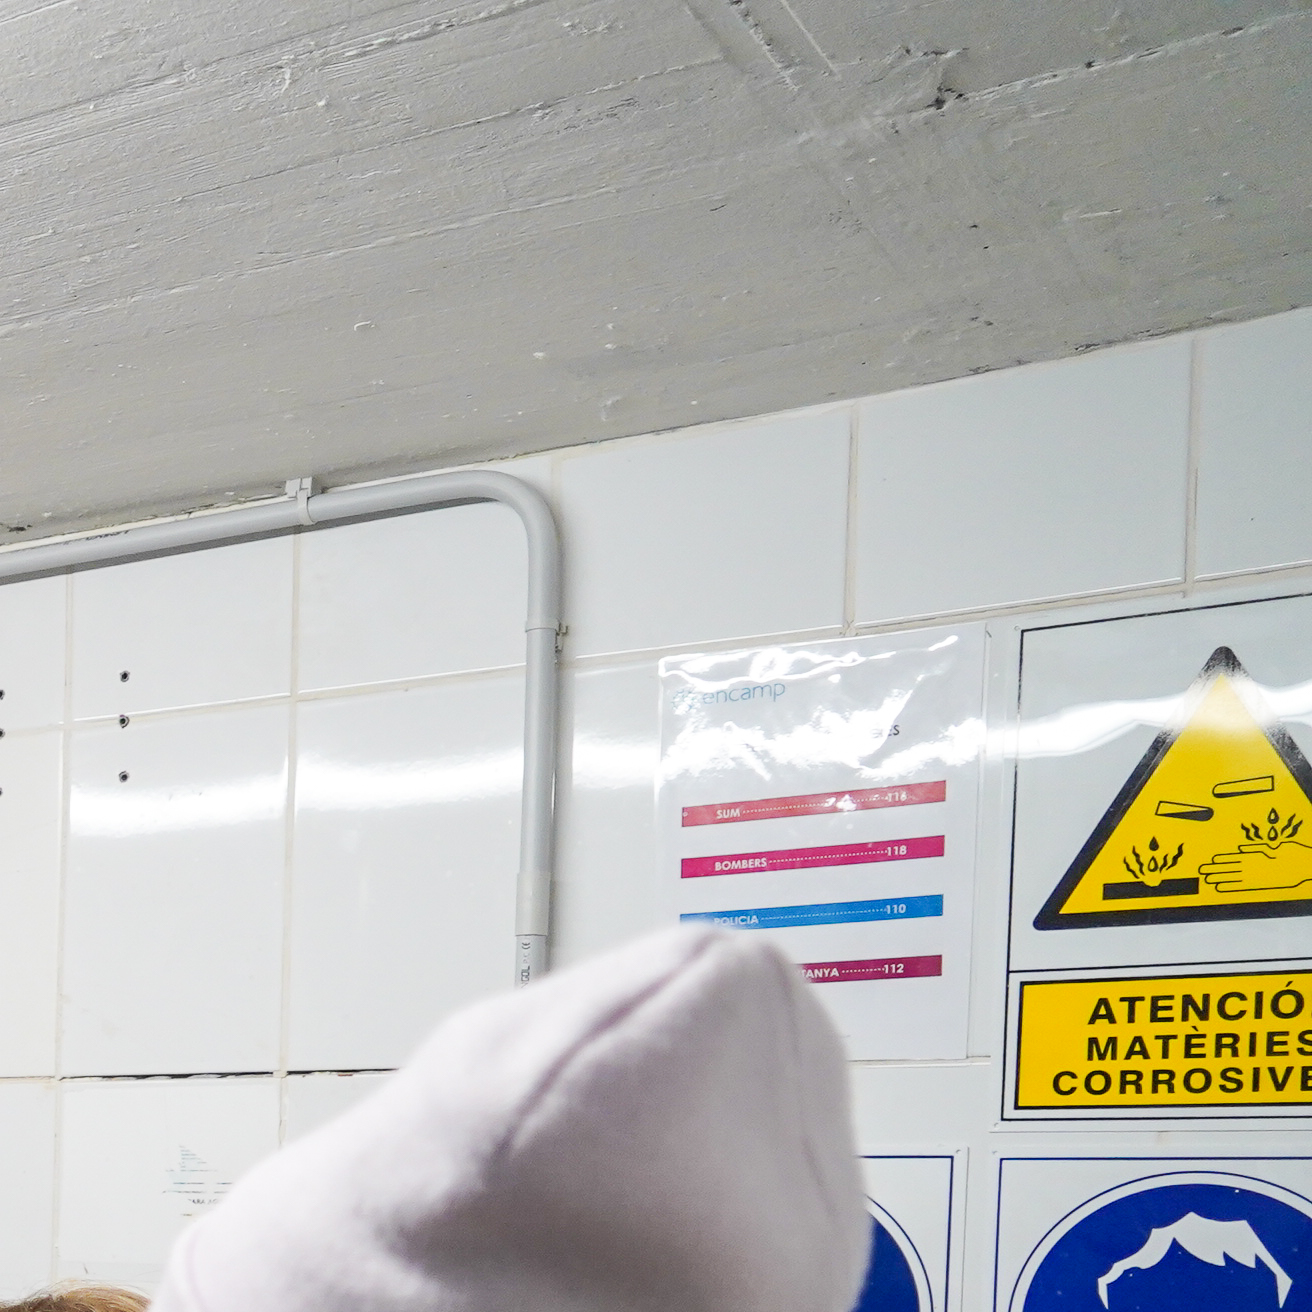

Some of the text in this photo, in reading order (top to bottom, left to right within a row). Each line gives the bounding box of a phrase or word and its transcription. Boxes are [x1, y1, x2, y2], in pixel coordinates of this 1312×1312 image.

[703, 682, 786, 706] encamp
[716, 808, 741, 820] SUM
[714, 845, 908, 872] BOMBERS 118
[885, 903, 907, 915] 110
[883, 963, 905, 974] 112
